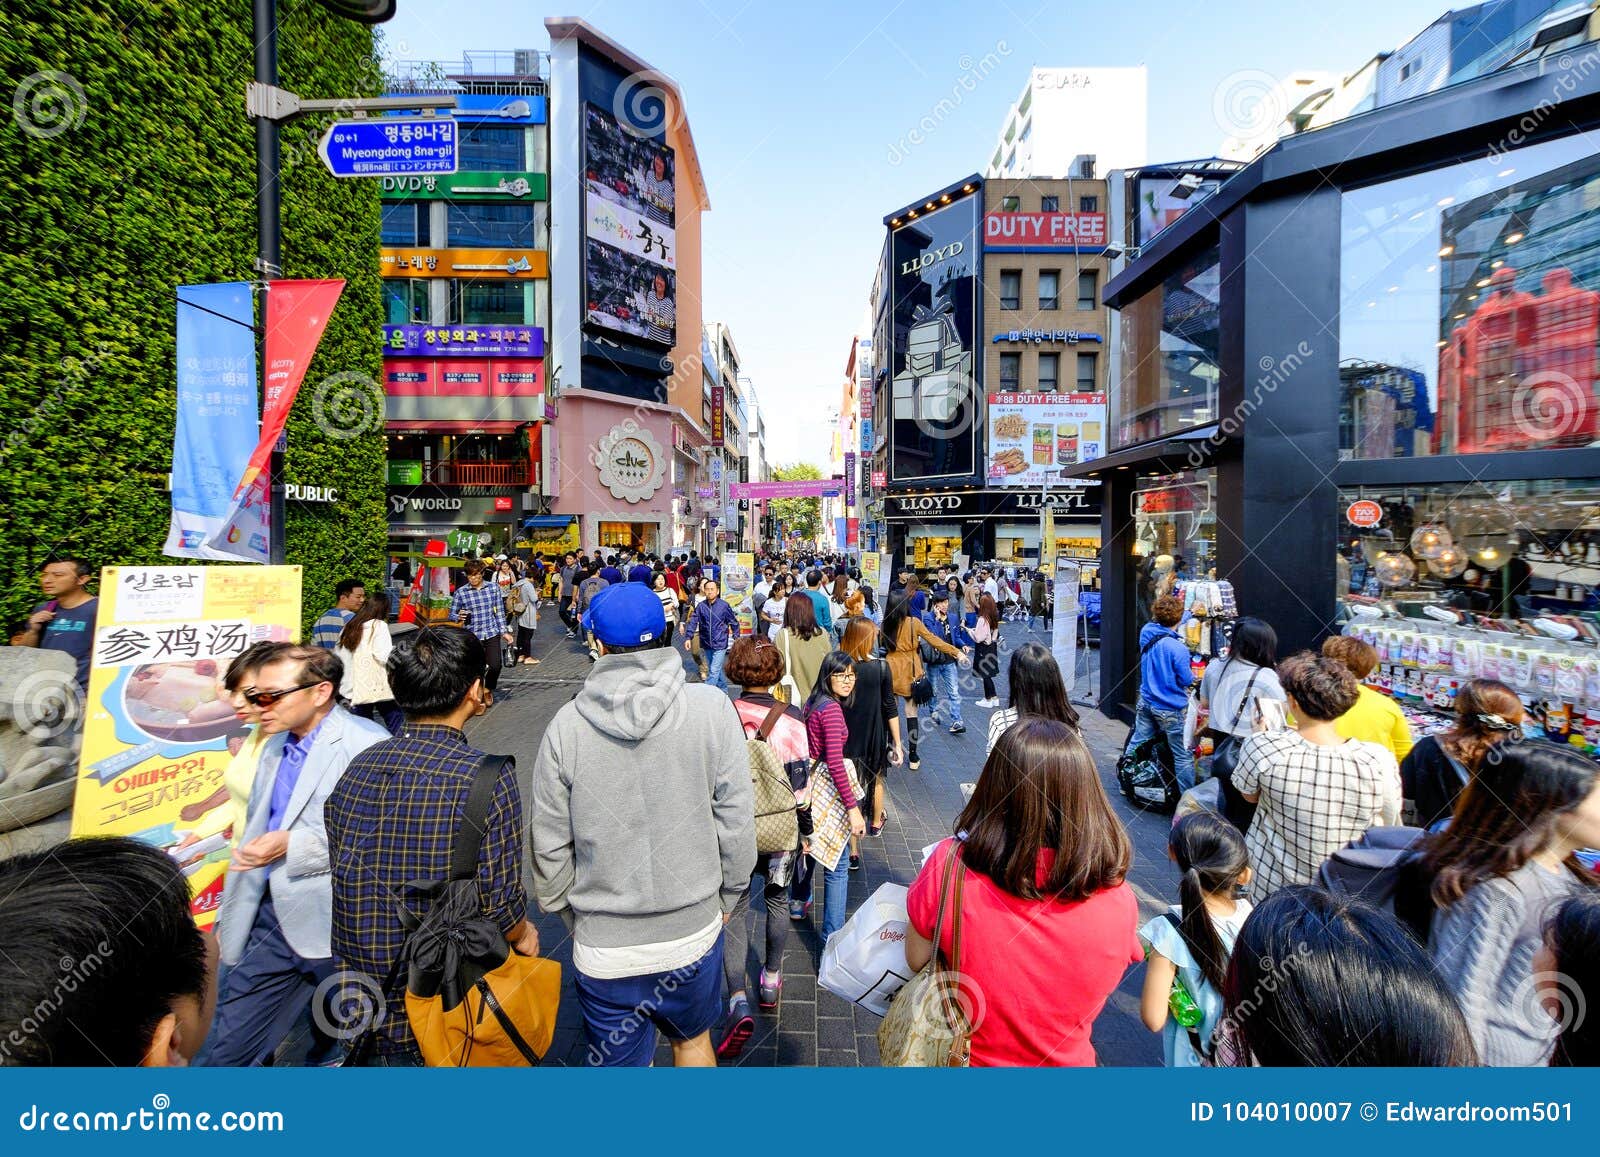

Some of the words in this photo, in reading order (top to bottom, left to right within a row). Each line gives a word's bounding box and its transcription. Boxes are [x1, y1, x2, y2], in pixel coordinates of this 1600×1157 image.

[334, 134, 345, 143] 60
[385, 124, 452, 143] 명동8나길
[342, 146, 412, 160] Myeongdong
[414, 145, 452, 159] 8na-gil
[383, 175, 437, 191] DVD방
[987, 216, 1044, 237] DUTY
[1050, 216, 1104, 237] FREE
[636, 219, 670, 260] 중구
[398, 255, 438, 269] 노래방
[901, 241, 964, 275] LLOYD
[1017, 395, 1043, 403] DUTY
[1046, 395, 1071, 403] FREE
[285, 484, 338, 501] PUBLIC
[411, 498, 462, 510] WORLD
[900, 495, 962, 510] LLOYD
[456, 532, 474, 547] 1+1
[97, 622, 248, 665] 参鸡汤
[113, 756, 206, 794] 어때유?!
